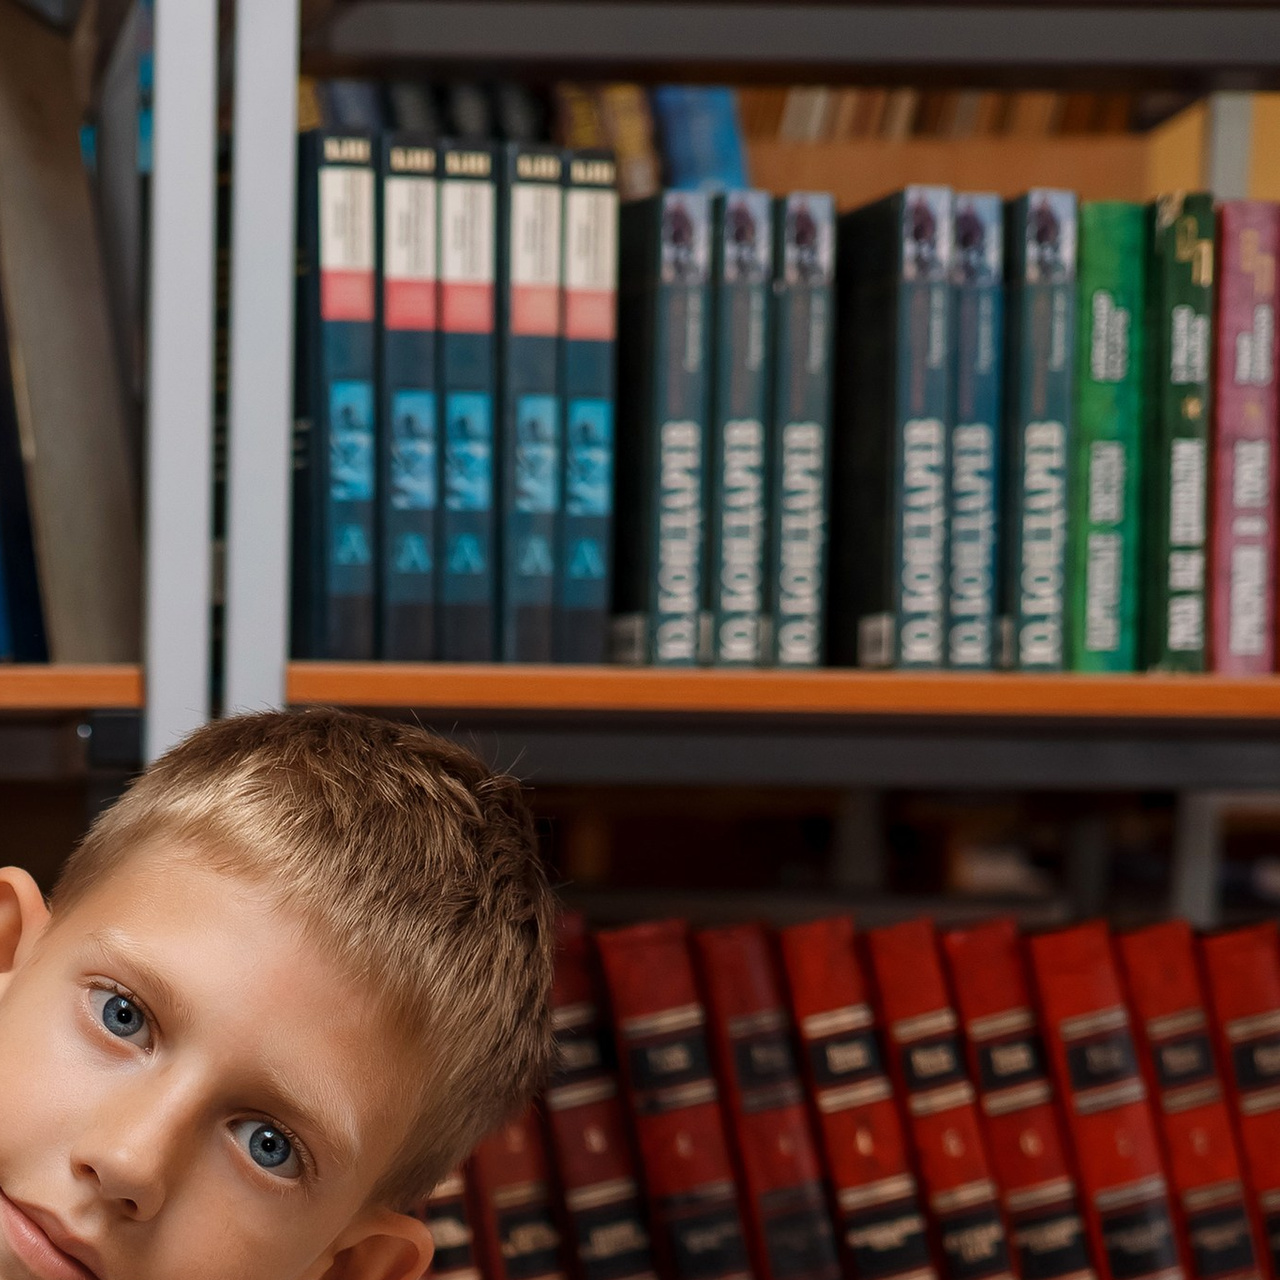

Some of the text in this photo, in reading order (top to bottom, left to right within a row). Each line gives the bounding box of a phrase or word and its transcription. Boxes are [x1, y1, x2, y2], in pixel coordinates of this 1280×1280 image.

[658, 420, 702, 614] БОНДАРЕВ
[720, 419, 764, 613] БОНДАРЕВ
[780, 421, 824, 615] БОНДАРЕВ
[901, 418, 946, 613] БОНДАРЕВ
[950, 421, 995, 615] БОНДАРЕВ
[1021, 420, 1069, 615] БОНДАРЕВ
